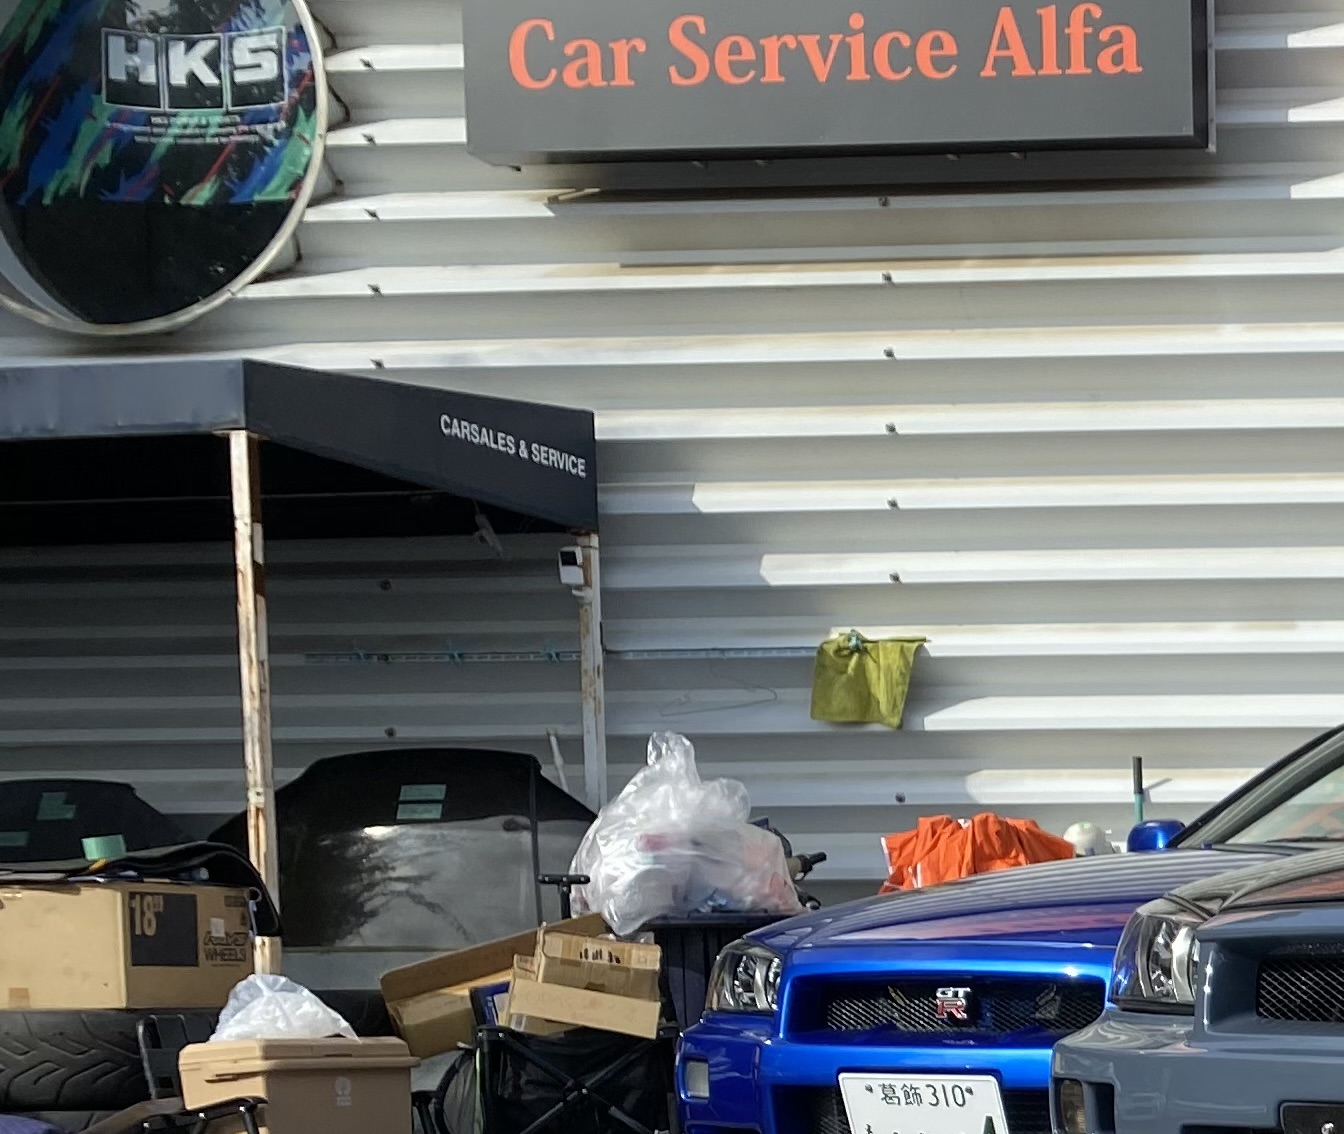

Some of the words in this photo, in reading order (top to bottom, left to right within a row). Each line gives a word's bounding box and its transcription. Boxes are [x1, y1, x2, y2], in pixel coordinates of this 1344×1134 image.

[107, 34, 281, 88] HKS
[507, 18, 647, 90] Car
[668, 13, 960, 87] Service
[980, 3, 1144, 79] Alfa
[440, 413, 516, 455] CARSALES
[518, 440, 530, 460] &
[531, 443, 587, 478] SERVICE
